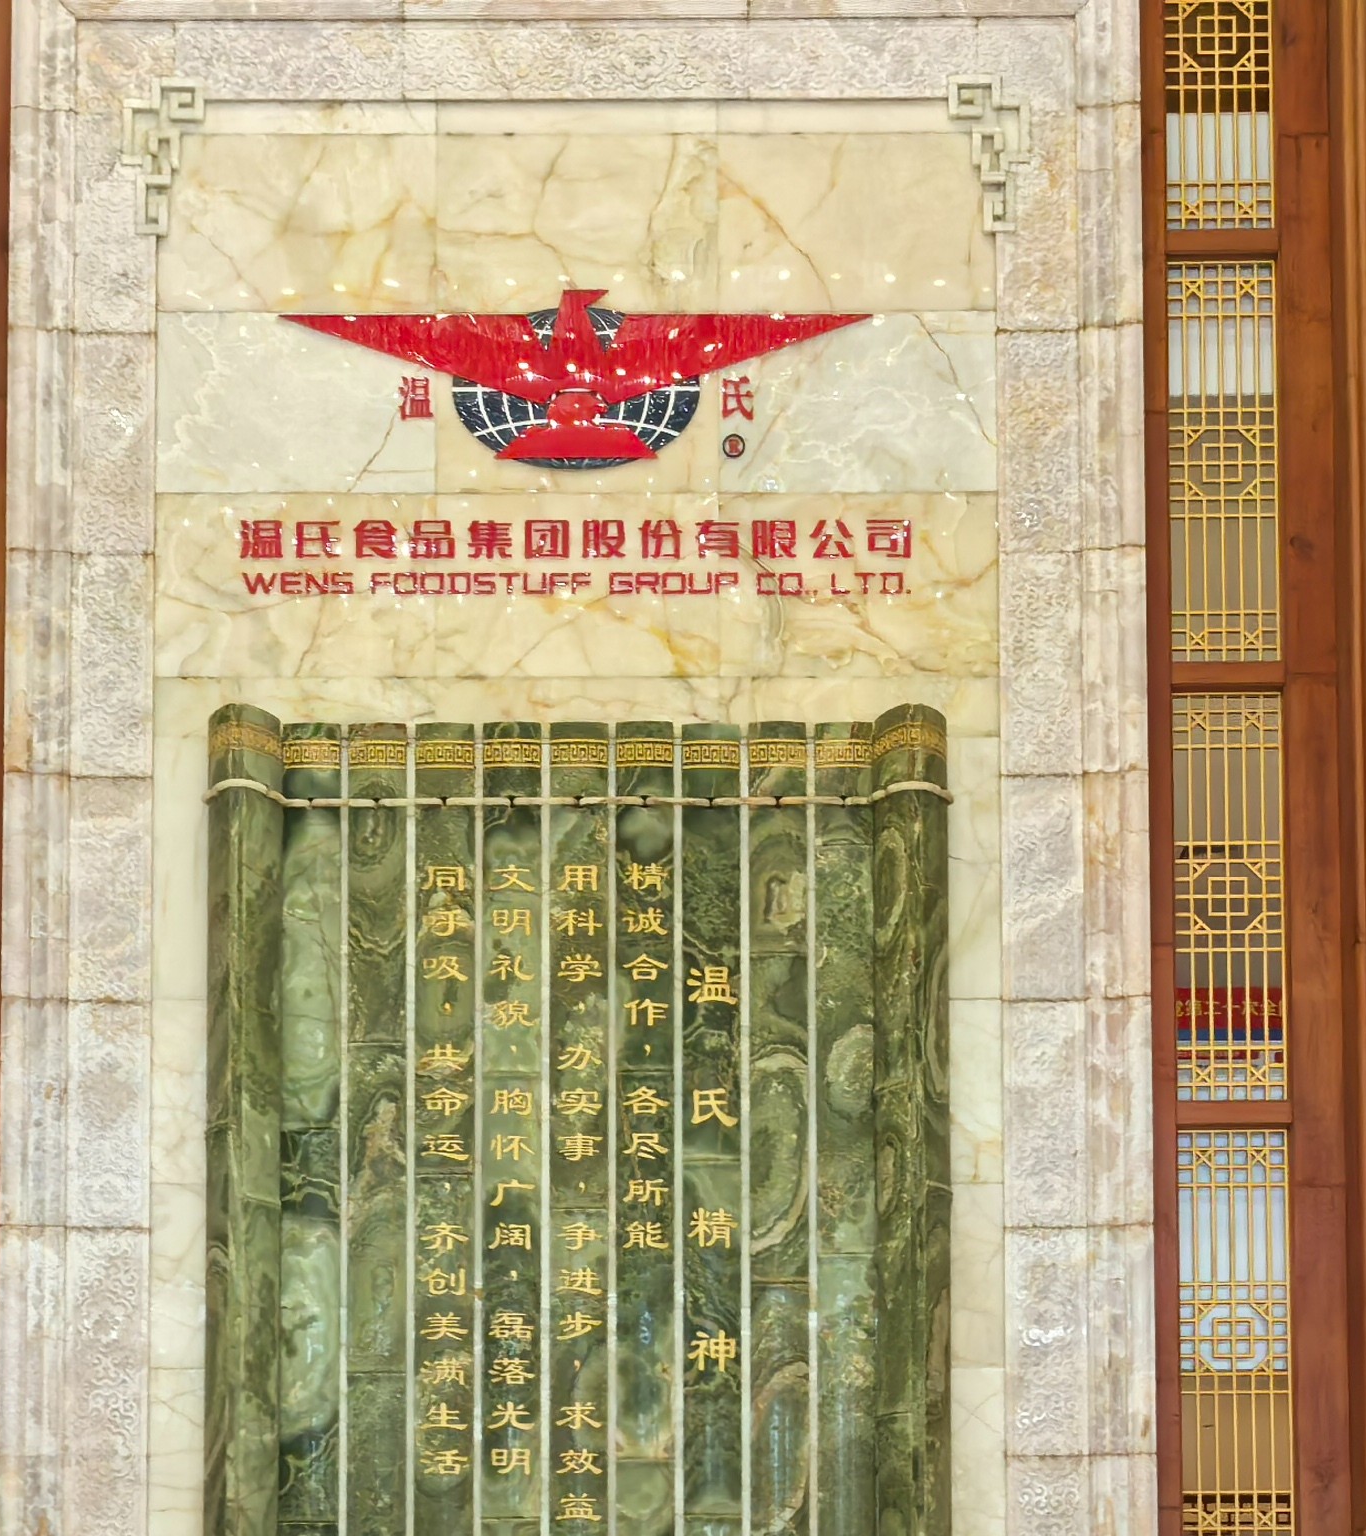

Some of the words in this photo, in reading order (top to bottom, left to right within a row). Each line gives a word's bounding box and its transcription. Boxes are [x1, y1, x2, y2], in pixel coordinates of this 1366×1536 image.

[398, 376, 434, 421] 温
[721, 377, 756, 422] 氏
[240, 519, 911, 559] 温氏食品集团股份有限公司
[242, 572, 354, 595] WENS
[371, 572, 592, 595] FOODSTUFF
[609, 572, 738, 595] GROUP
[831, 572, 911, 595] LTD.
[685, 966, 738, 1373] 温氏精神
